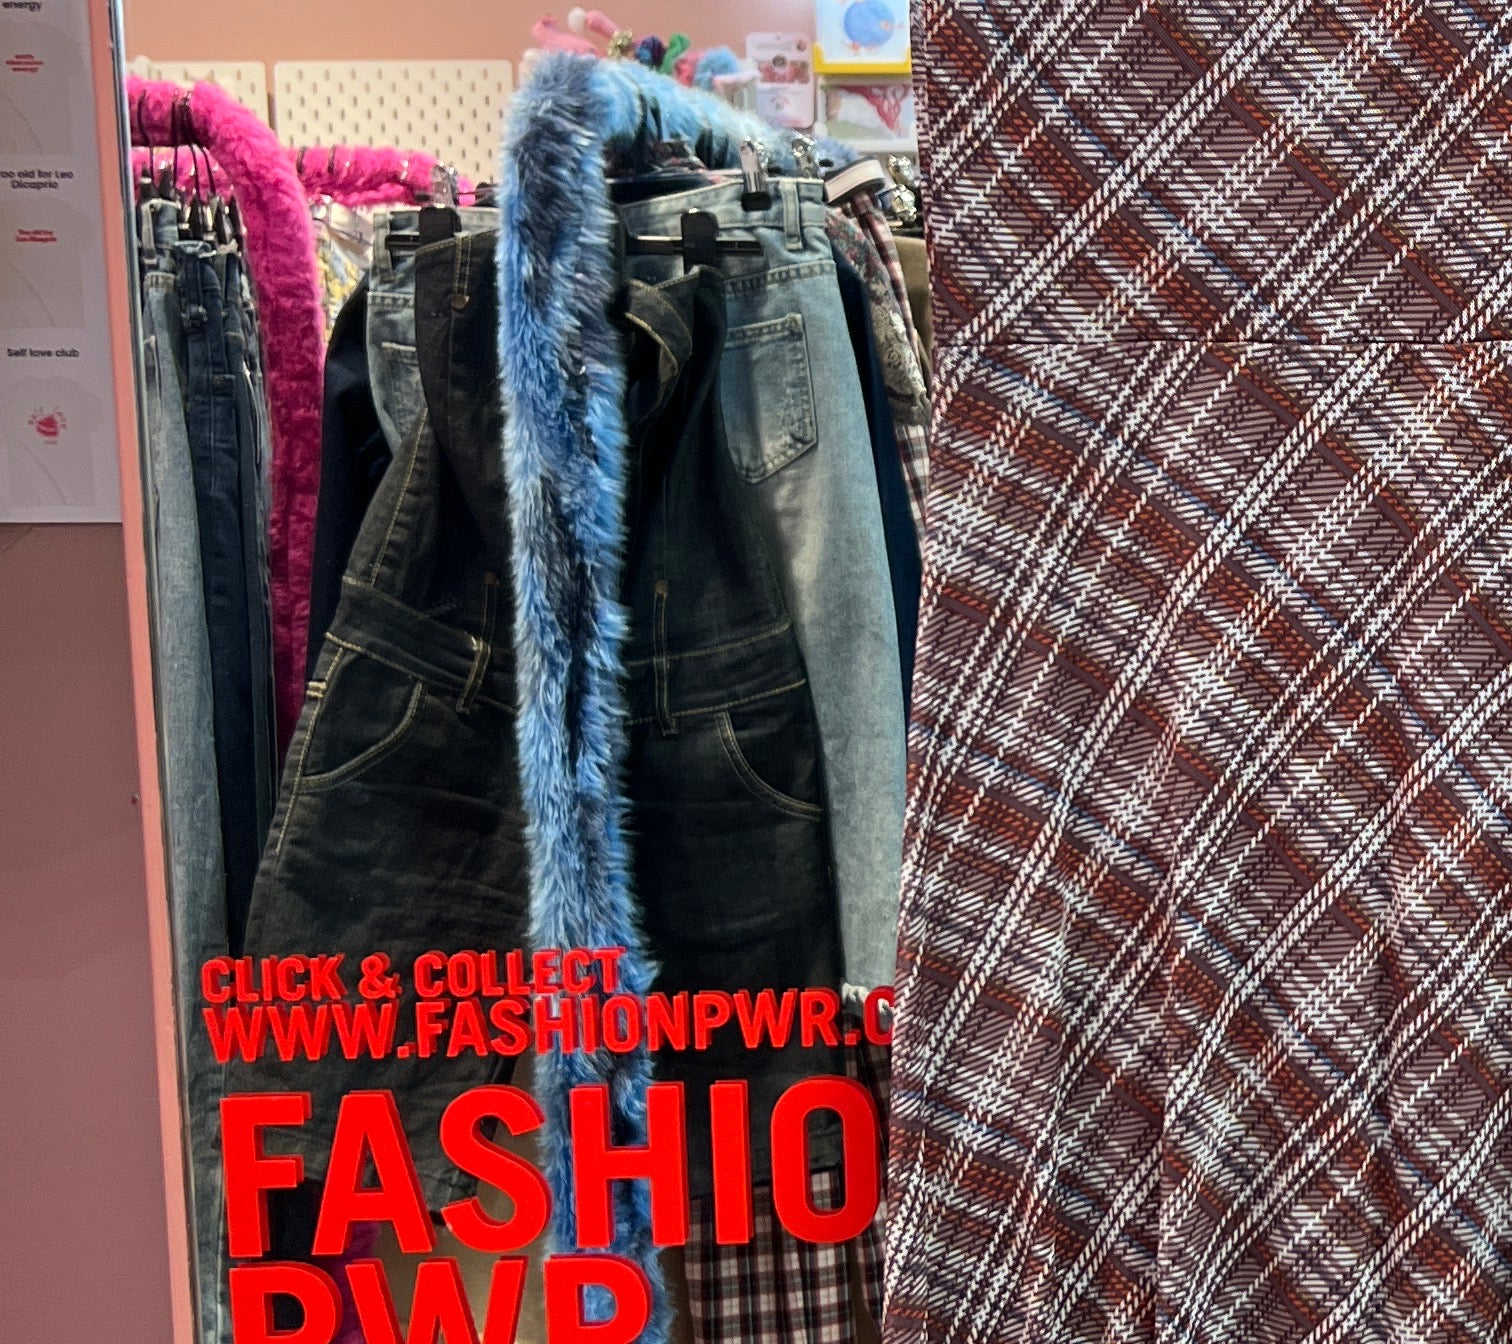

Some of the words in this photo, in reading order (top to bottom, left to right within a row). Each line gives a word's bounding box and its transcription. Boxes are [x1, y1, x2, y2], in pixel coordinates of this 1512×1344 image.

[2, 1, 42, 12] energy
[29, 348, 53, 357] love
[55, 348, 80, 357] club
[200, 953, 346, 1003] CLICK
[357, 953, 399, 999] &
[413, 947, 627, 999] COLLECT
[219, 1076, 880, 1257] FASHIO
